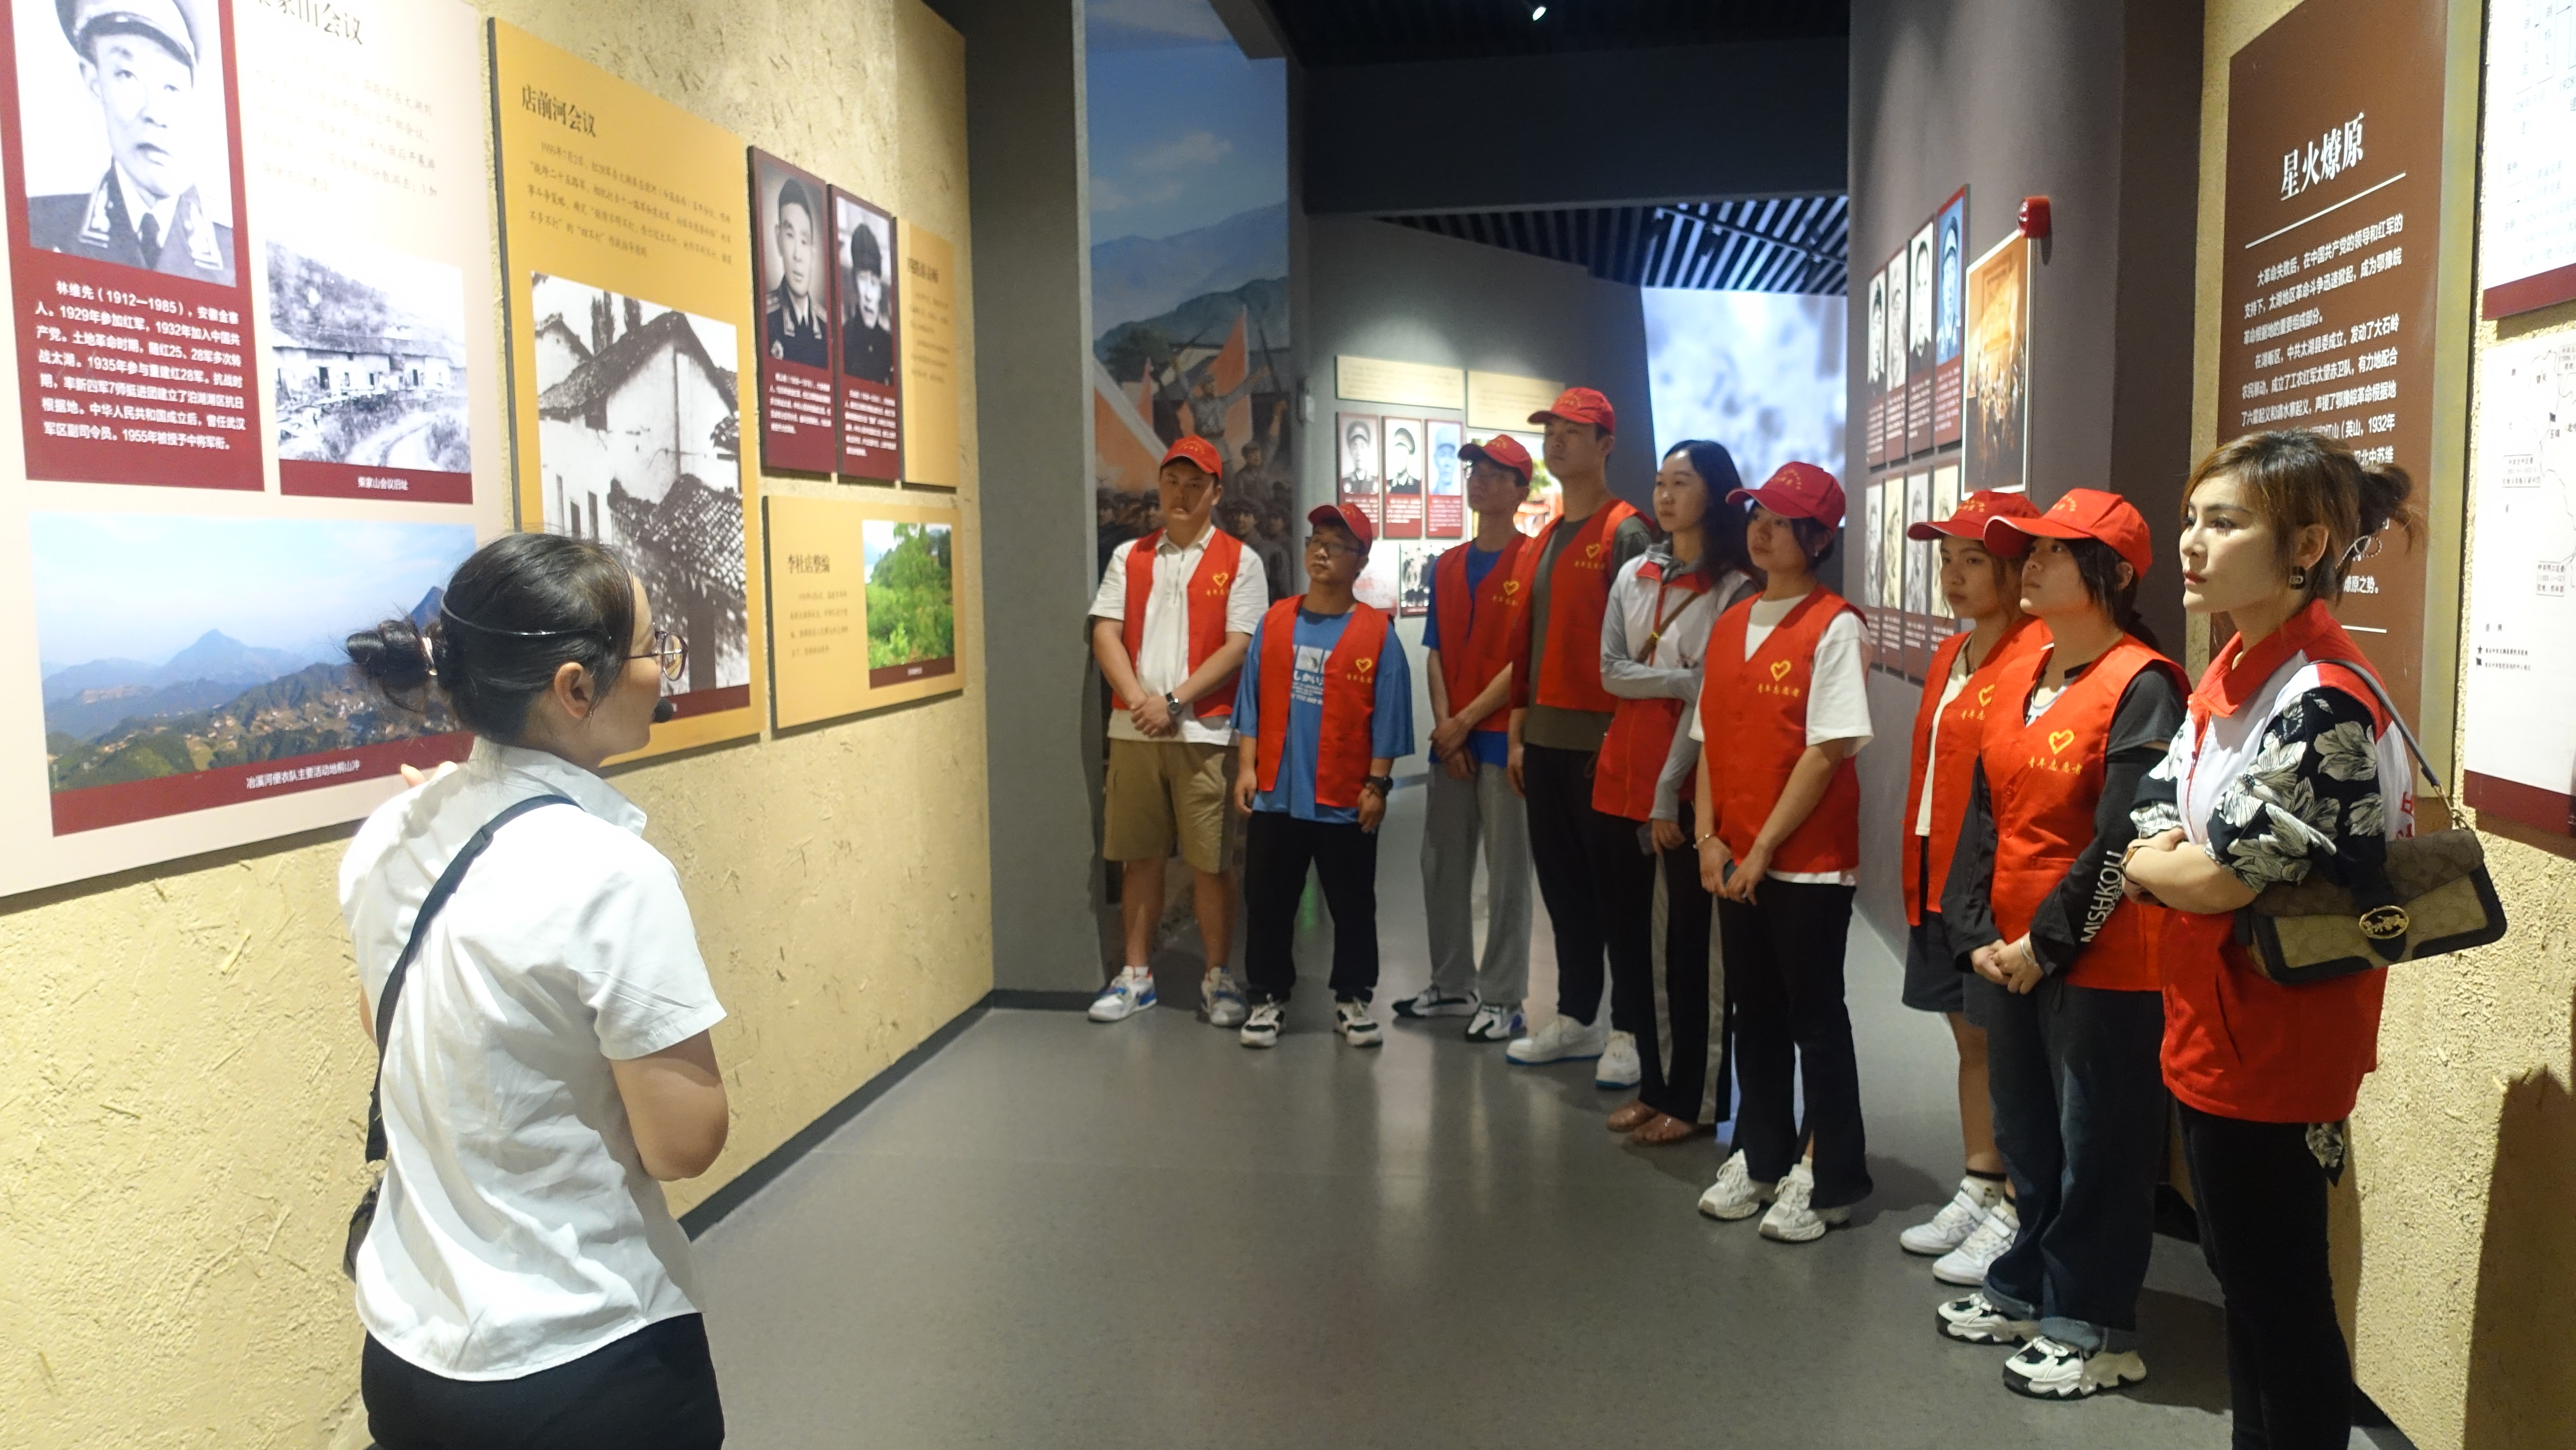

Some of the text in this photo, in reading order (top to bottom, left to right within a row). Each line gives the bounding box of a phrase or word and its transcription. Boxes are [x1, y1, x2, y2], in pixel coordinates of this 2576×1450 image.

[522, 85, 596, 138] 店前河会议
[2280, 113, 2365, 201] 星火燎原
